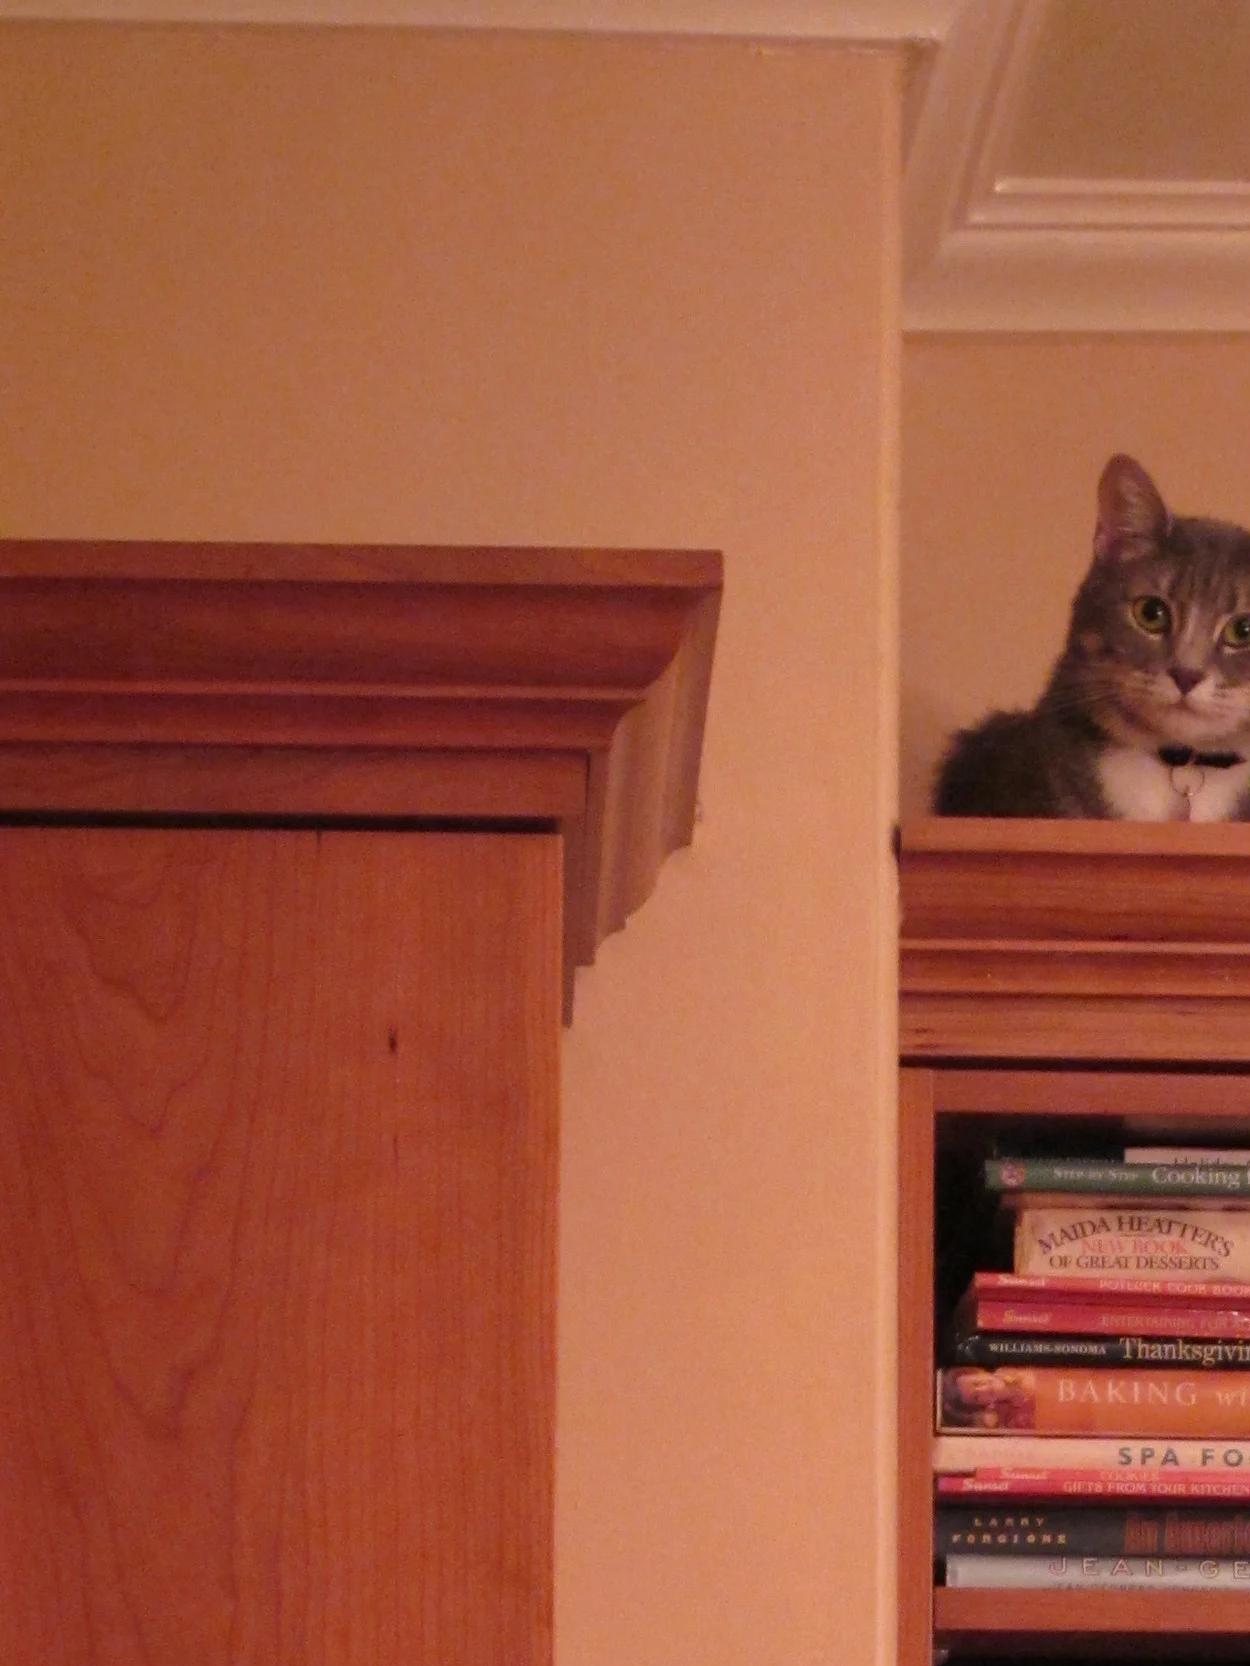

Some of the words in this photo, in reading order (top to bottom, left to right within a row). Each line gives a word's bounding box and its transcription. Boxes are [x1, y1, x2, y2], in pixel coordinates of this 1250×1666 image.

[1151, 1166, 1240, 1190] Cooking
[1037, 1218, 1111, 1255] MAIDA
[1116, 1215, 1235, 1259] HEATTER'S
[1082, 1239, 1128, 1255] NEW
[1134, 1239, 1189, 1256] BOOK
[1049, 1255, 1070, 1269] OF
[1076, 1255, 1131, 1269] GREAT
[1135, 1255, 1219, 1270] DESSERTS
[989, 1342, 1107, 1356] WILLIAMS-SONOMA
[1057, 1378, 1198, 1406] BAKING
[1117, 1446, 1180, 1467] SPA
[1191, 1483, 1250, 1496] KITCHEN
